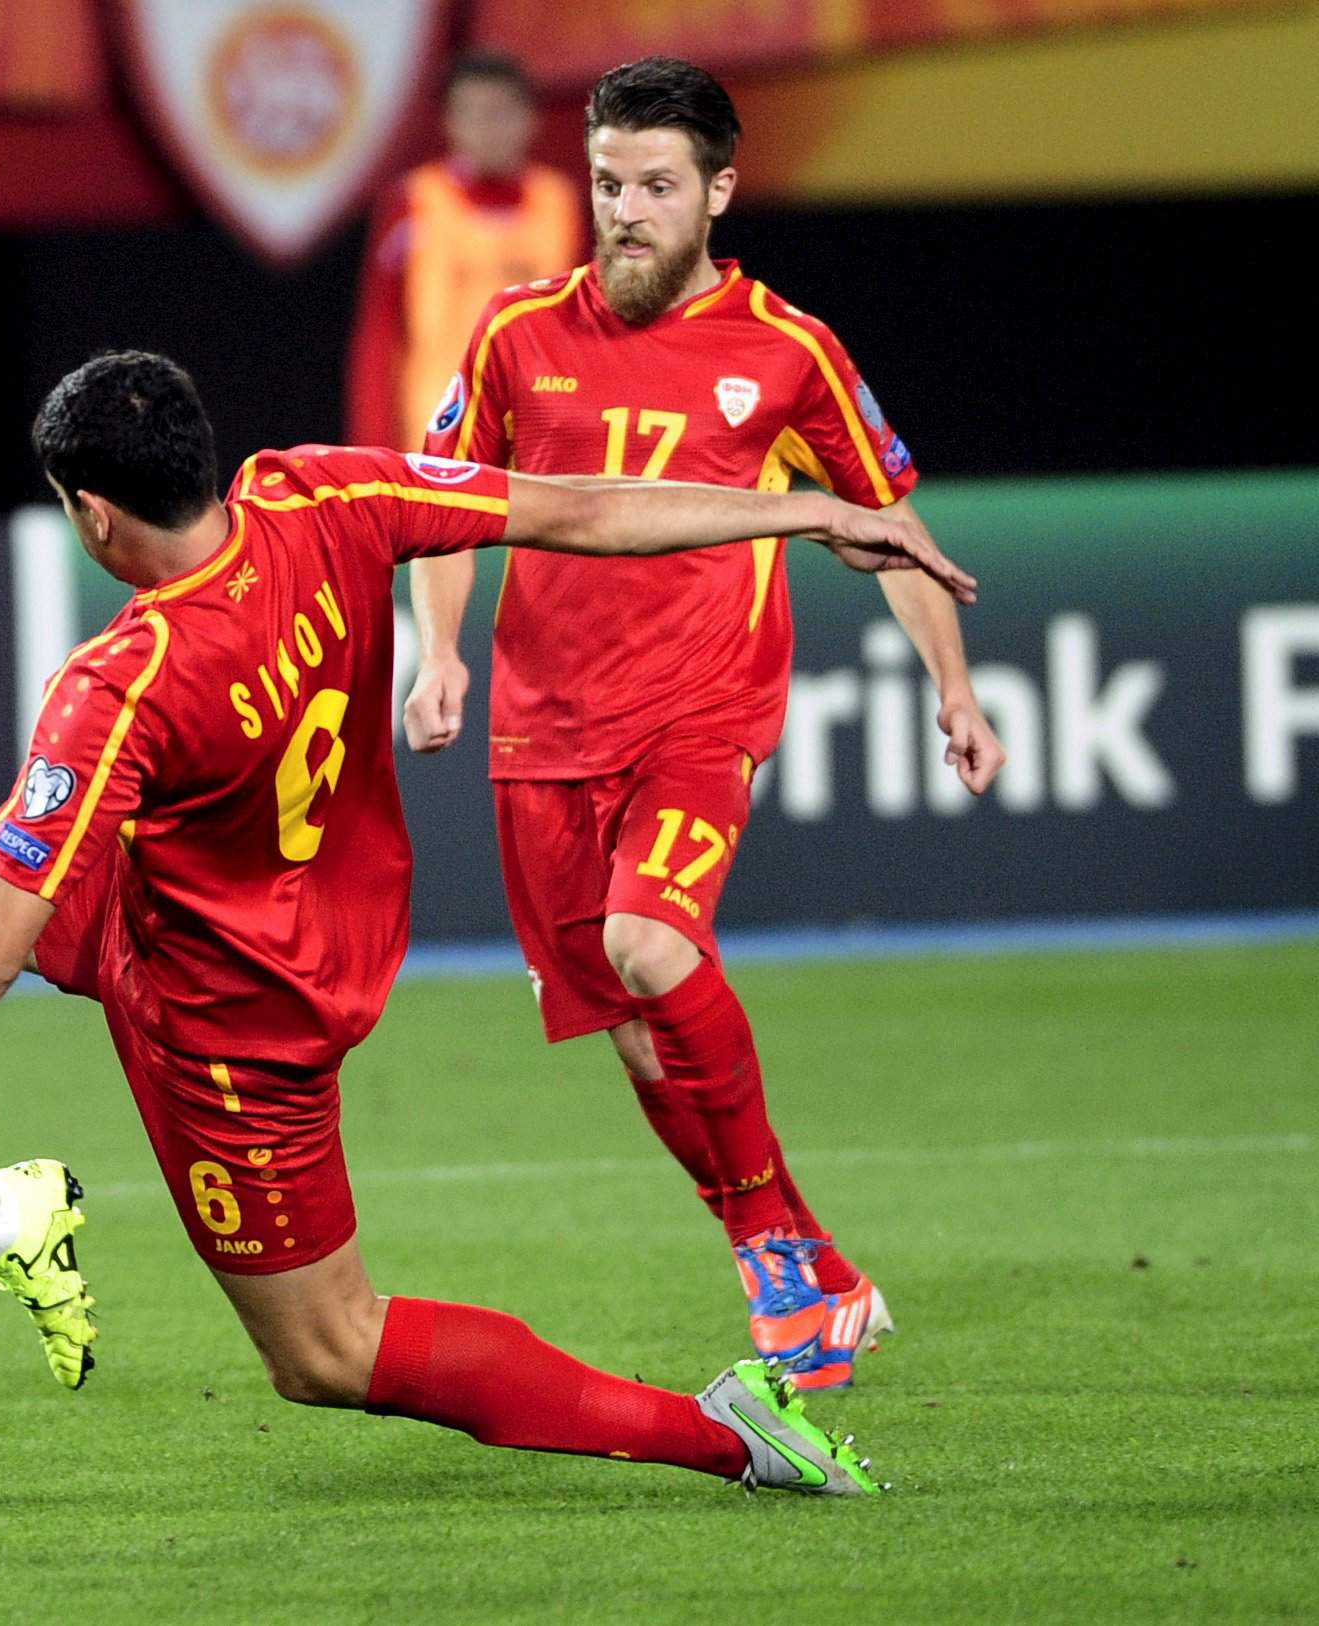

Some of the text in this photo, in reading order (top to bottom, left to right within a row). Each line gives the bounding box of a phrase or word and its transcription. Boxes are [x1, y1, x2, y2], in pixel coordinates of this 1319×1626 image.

[531, 375, 579, 393] JAKO
[600, 407, 687, 481] 17
[748, 608, 1176, 823] rink
[275, 688, 350, 862] 6
[636, 808, 727, 889] 17
[660, 885, 701, 920] JAKO
[188, 1160, 242, 1235] 6
[215, 1238, 264, 1255] JAKO
